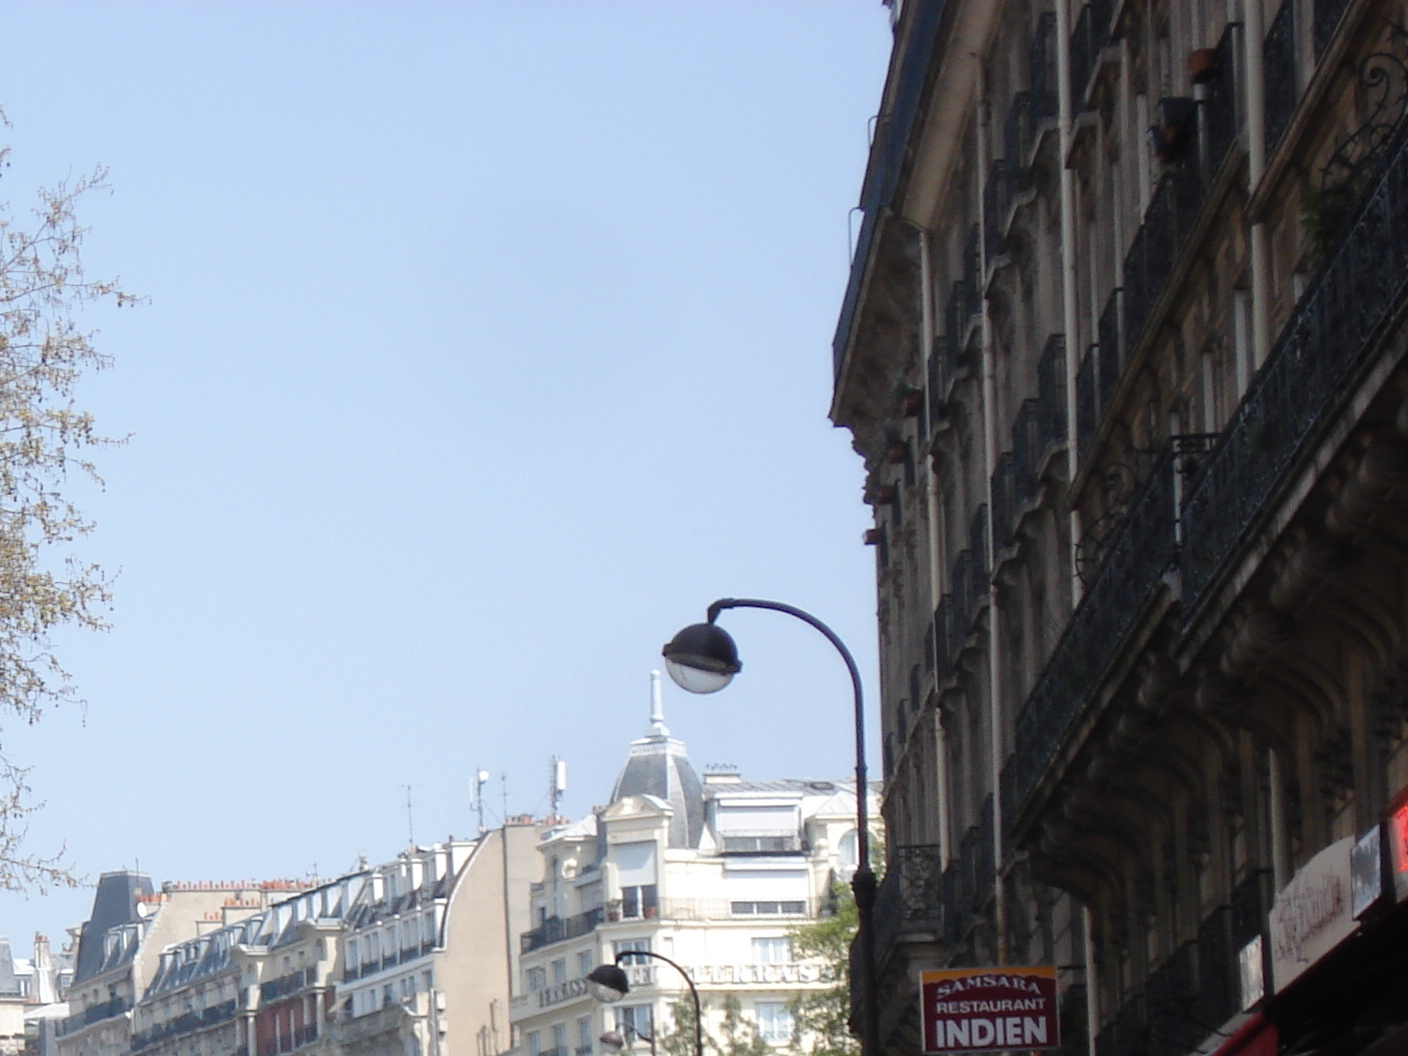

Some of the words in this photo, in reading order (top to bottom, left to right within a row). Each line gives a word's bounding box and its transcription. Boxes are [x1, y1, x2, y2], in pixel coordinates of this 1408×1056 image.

[936, 975, 1041, 999] SAMSARA
[936, 999, 1045, 1014] RESTAURANT
[935, 1017, 1047, 1048] INDIEN
